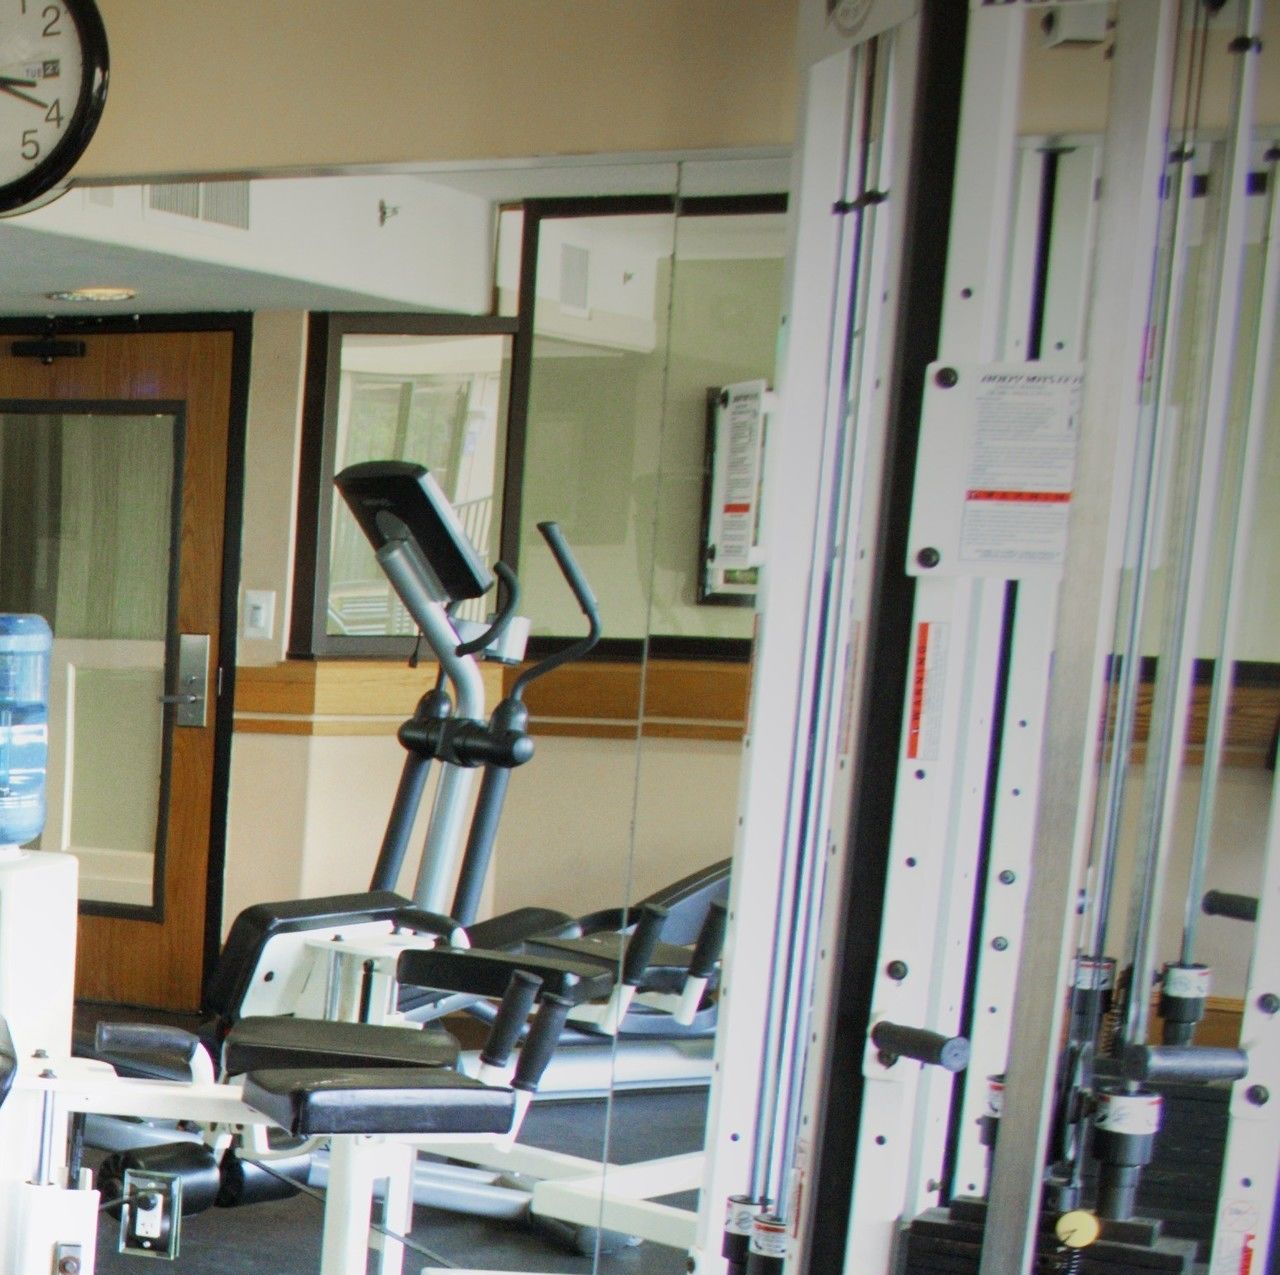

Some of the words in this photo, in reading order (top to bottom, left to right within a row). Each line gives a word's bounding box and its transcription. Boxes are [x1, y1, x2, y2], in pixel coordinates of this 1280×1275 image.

[42, 6, 61, 37] 2
[44, 98, 64, 129] 4
[21, 130, 40, 160] 5
[912, 645, 927, 721] WARNING
